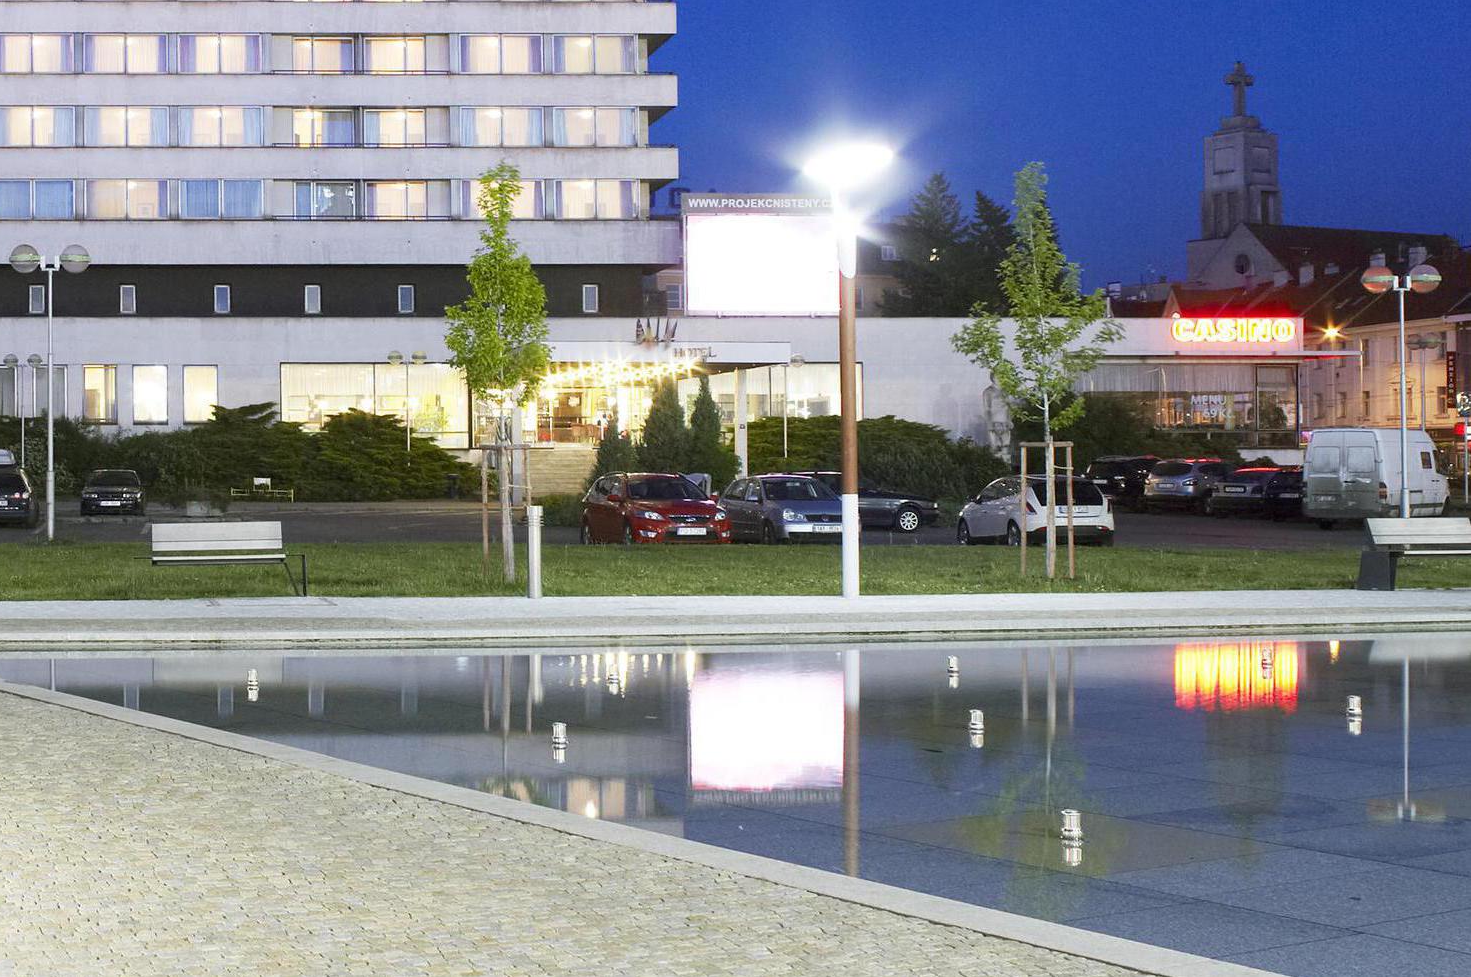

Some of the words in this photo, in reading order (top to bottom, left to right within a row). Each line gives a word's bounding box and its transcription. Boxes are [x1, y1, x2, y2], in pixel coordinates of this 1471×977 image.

[688, 198, 834, 208] WWW.PROJEKCNISTENY.C
[1172, 318, 1296, 343] CASINO
[1191, 394, 1227, 405] MENU
